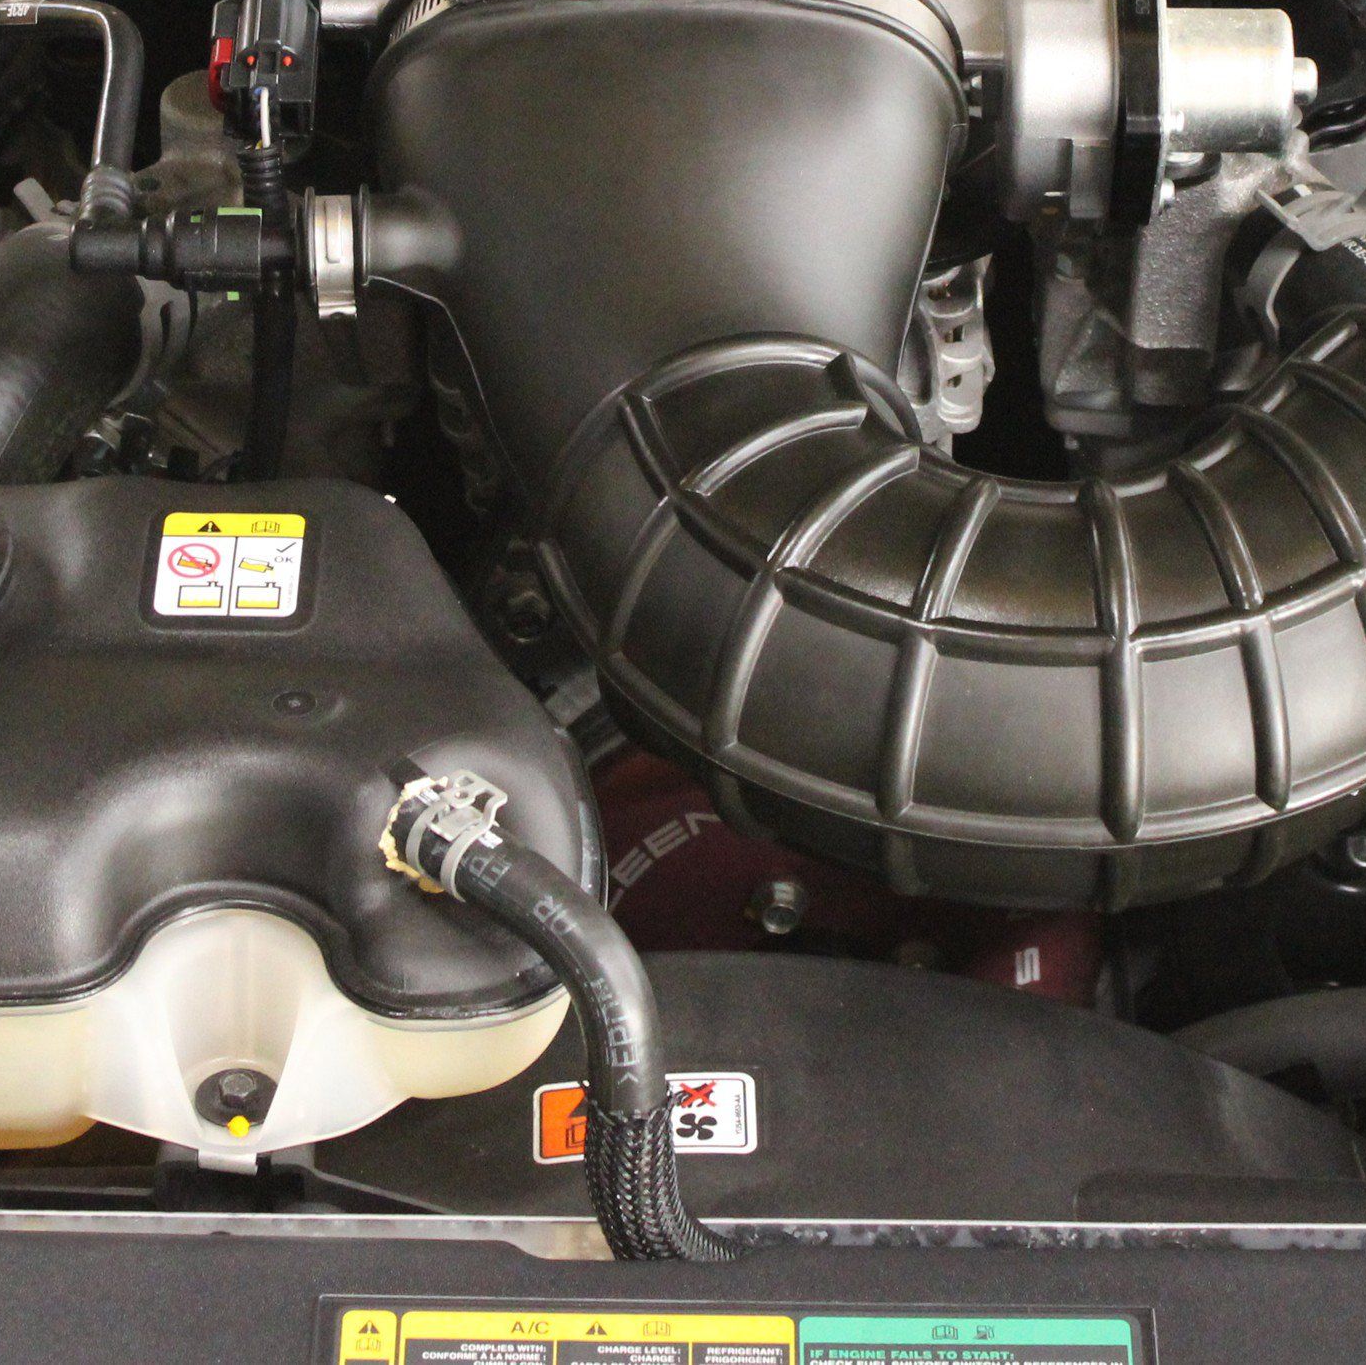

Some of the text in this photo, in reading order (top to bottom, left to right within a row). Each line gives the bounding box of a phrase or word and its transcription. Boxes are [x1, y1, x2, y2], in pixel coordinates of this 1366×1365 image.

[274, 555, 294, 564] OK
[511, 1320, 550, 1335] A/C
[460, 1343, 547, 1353] COMPLIES WITH:
[597, 1345, 681, 1355] CHARGE LEVEL:
[706, 1346, 783, 1356] REFRIGERANT:
[422, 1351, 478, 1360] CONFORME
[490, 1352, 502, 1360] LA
[505, 1352, 540, 1361] NORME
[629, 1354, 675, 1363] CHARGE
[809, 1349, 1015, 1361] IF ENGINE FAILS TO START:
